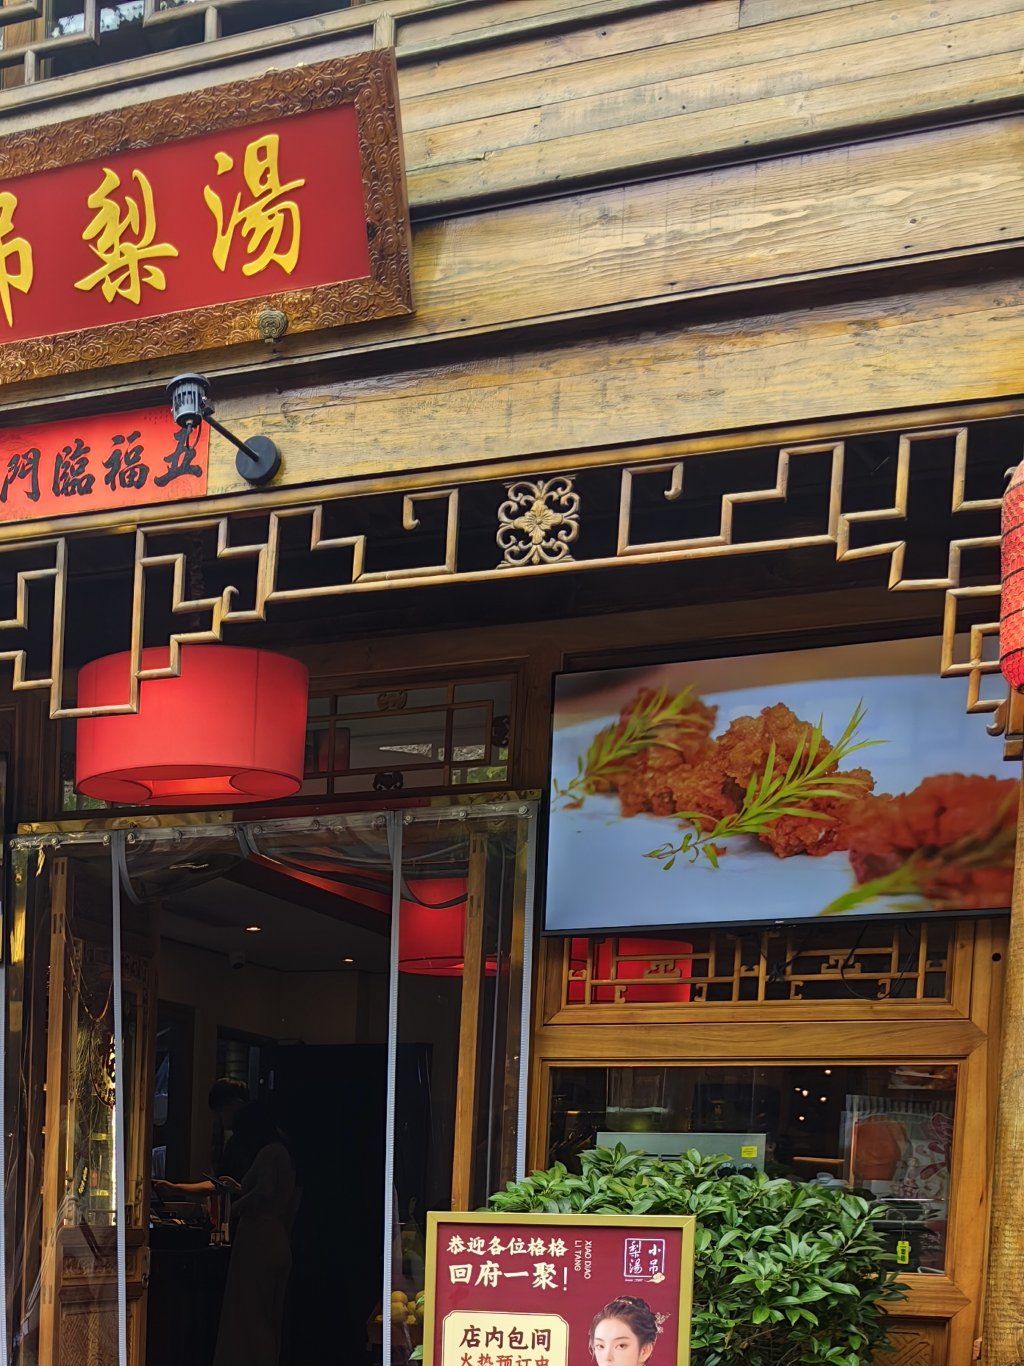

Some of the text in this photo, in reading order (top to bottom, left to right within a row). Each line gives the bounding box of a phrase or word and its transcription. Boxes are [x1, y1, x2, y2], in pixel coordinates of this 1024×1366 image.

[446, 1234, 569, 1258] 恭迎各位格格
[574, 1240, 582, 1272] LI TANG
[584, 1240, 593, 1280] XIAO DIAO
[459, 1324, 552, 1352] 店内包间
